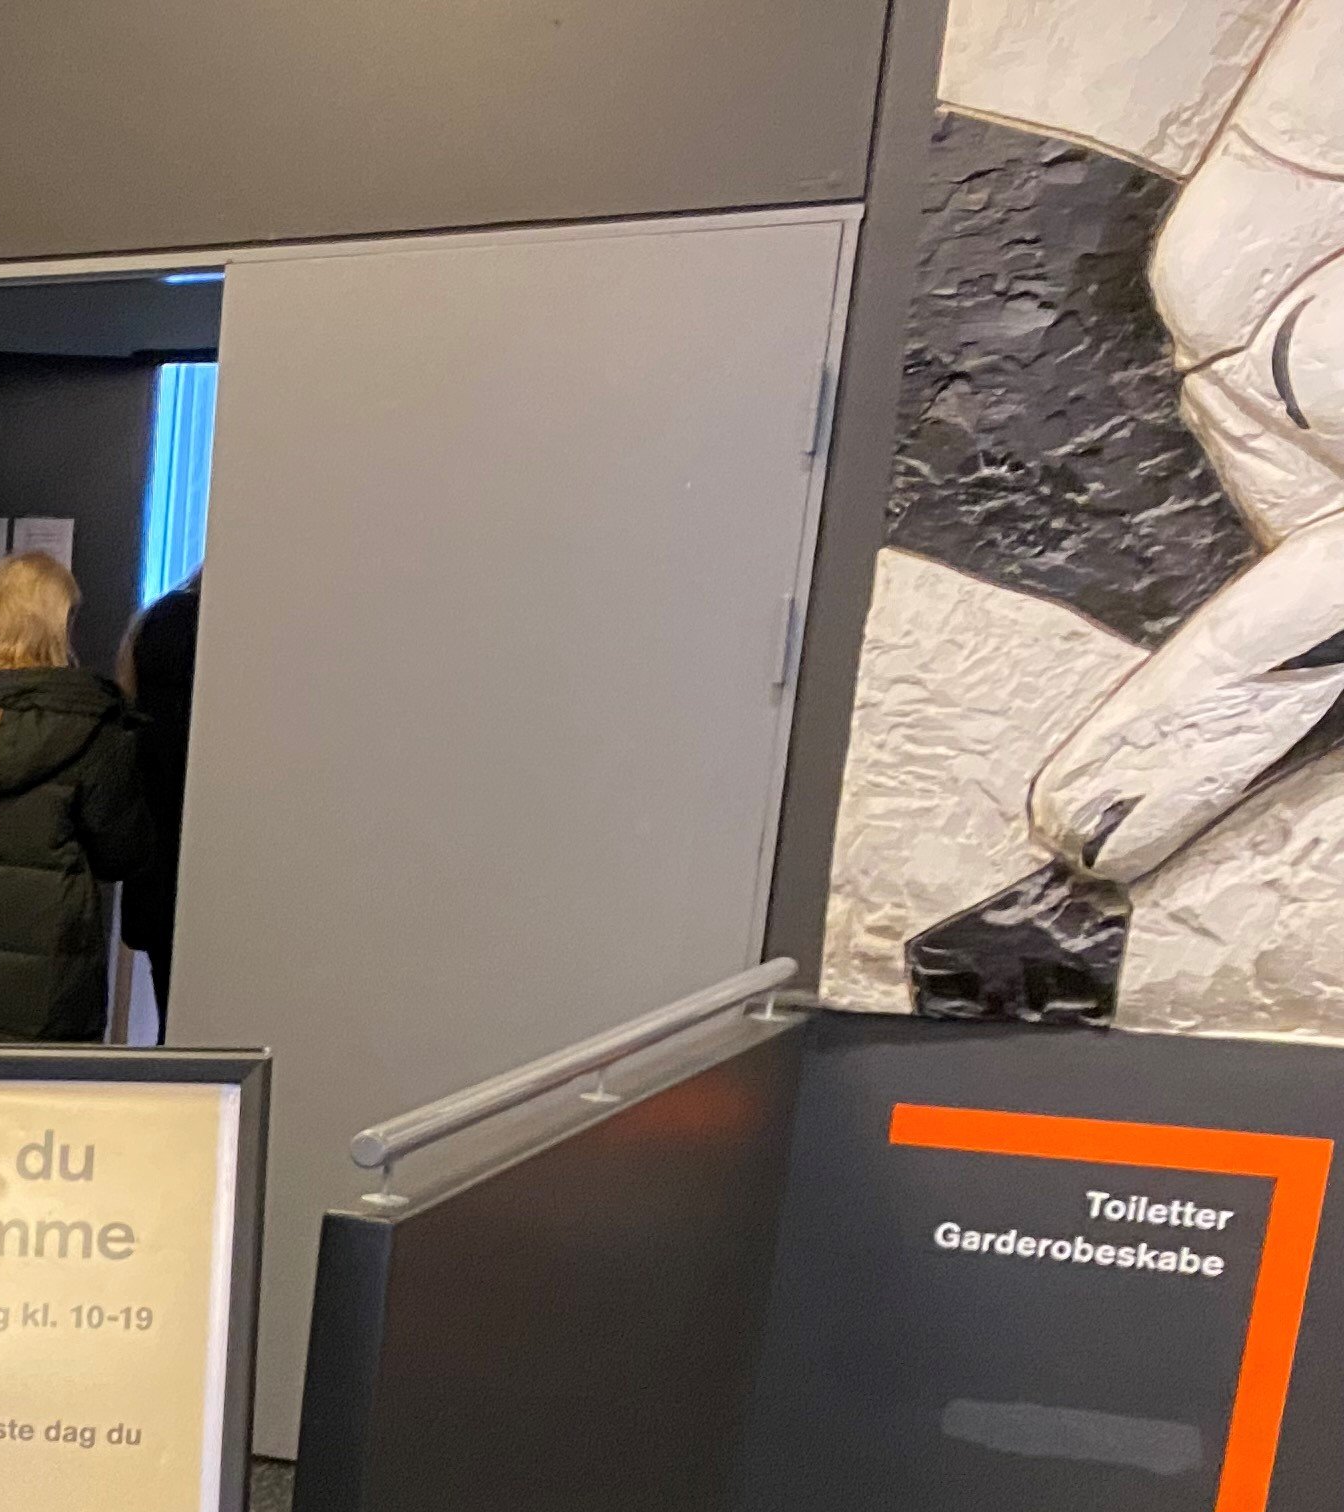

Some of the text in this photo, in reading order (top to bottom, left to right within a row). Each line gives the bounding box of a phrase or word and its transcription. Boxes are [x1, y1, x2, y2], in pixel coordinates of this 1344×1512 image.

[15, 1129, 95, 1181] du
[1086, 1190, 1235, 1231] Toiletter
[933, 1221, 1225, 1277] Garderobeskabe
[21, 1302, 58, 1328] kl.
[69, 1305, 154, 1331] 10-19
[44, 1420, 97, 1449] dag
[106, 1423, 143, 1446] du
